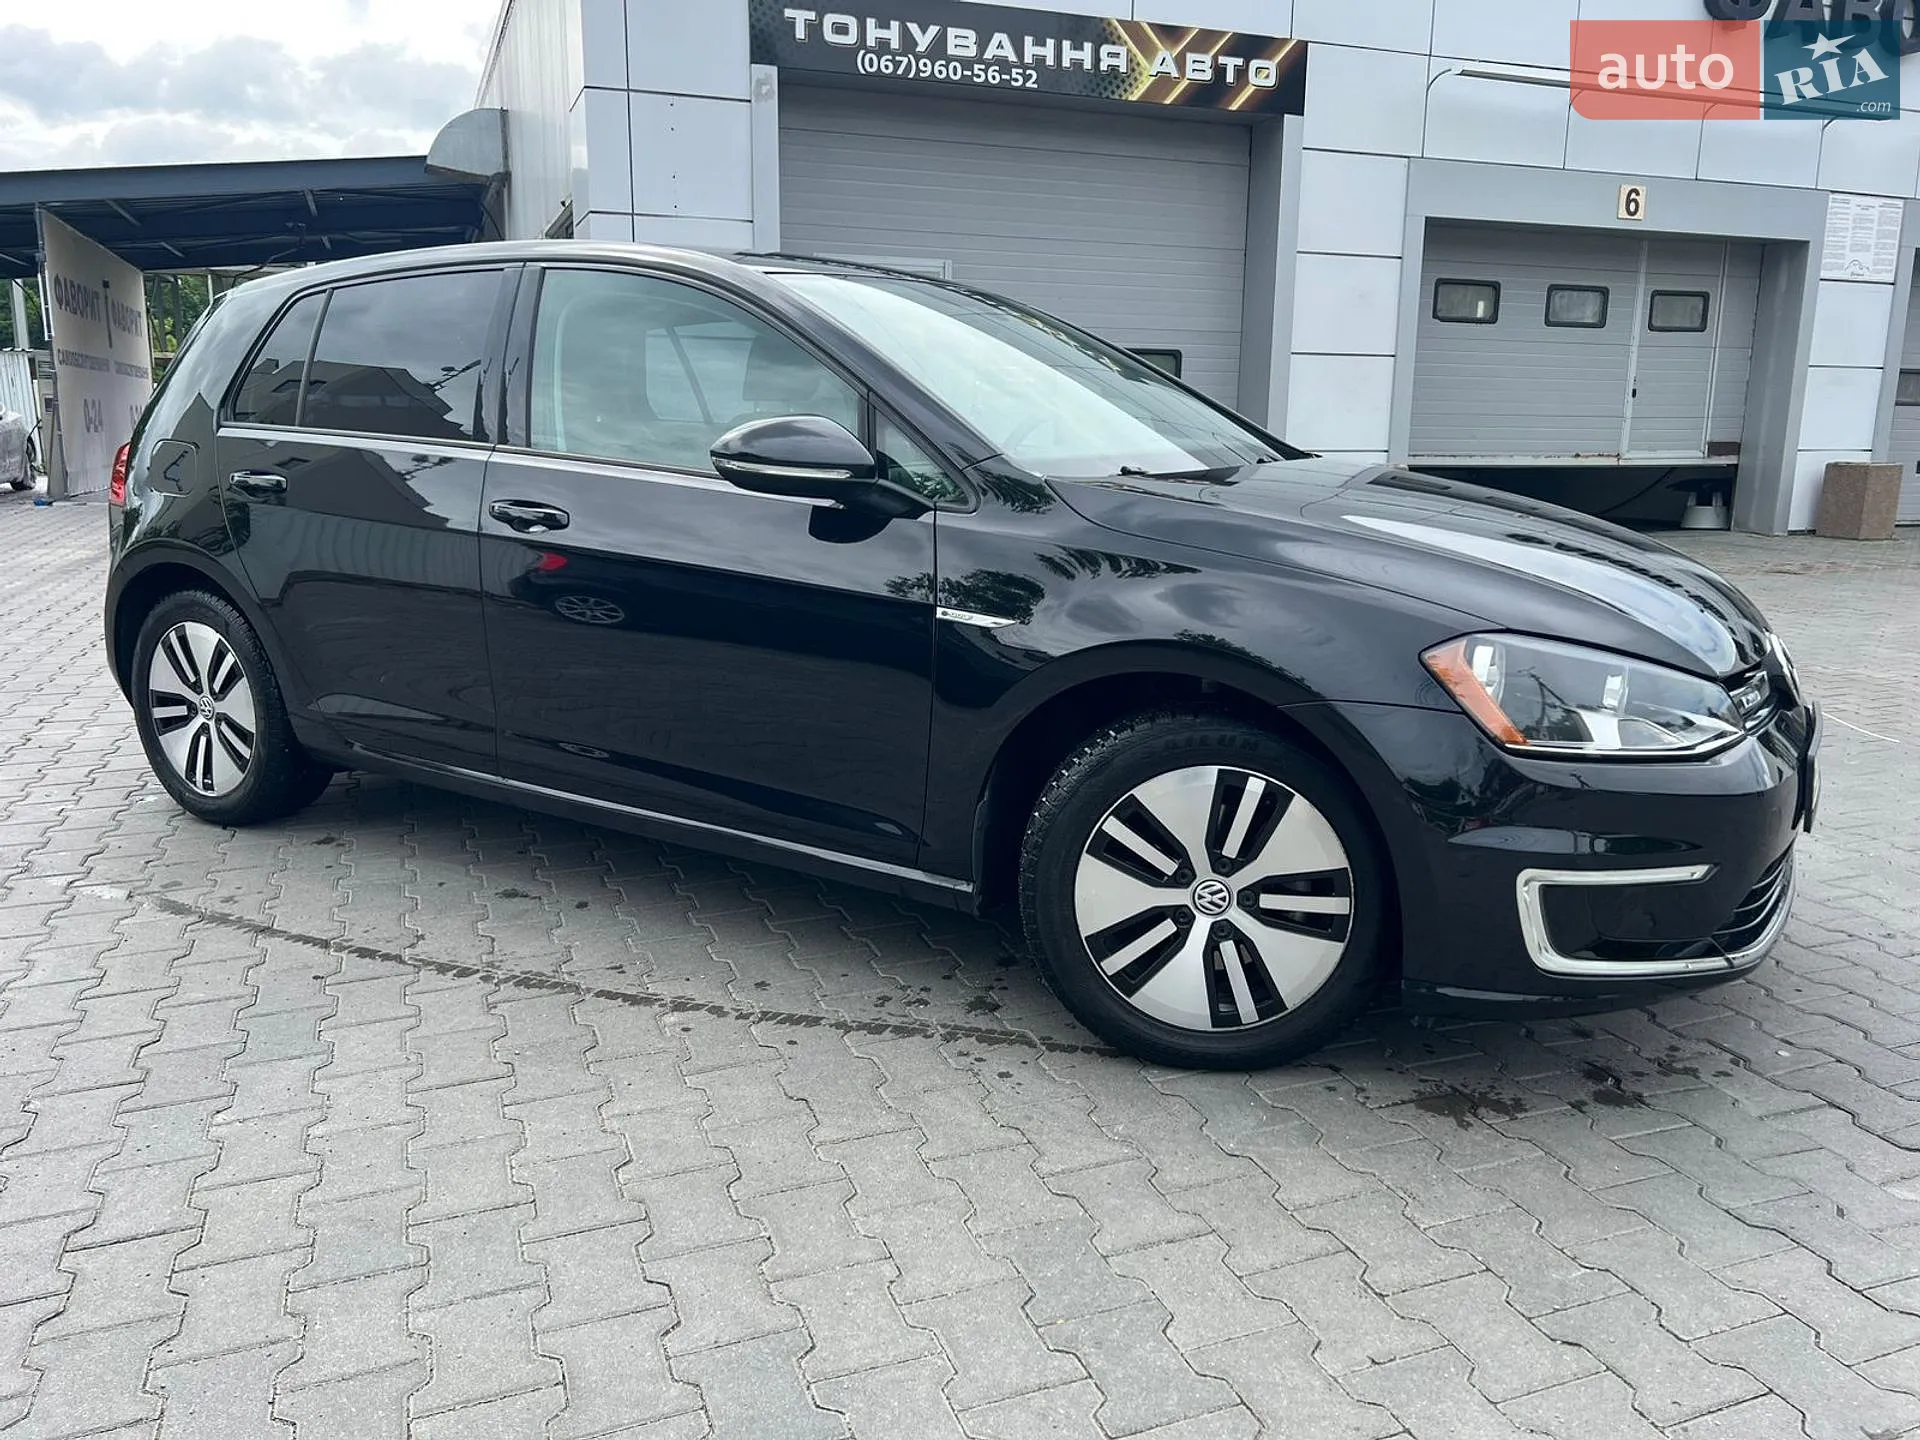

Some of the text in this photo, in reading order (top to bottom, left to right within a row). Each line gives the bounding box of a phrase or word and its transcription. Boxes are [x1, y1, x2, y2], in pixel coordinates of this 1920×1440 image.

[784, 8, 1279, 88] ТОНУВАННЯ АВТО
[856, 50, 1038, 88] (067)960-56-52
[1624, 188, 1640, 217] 6
